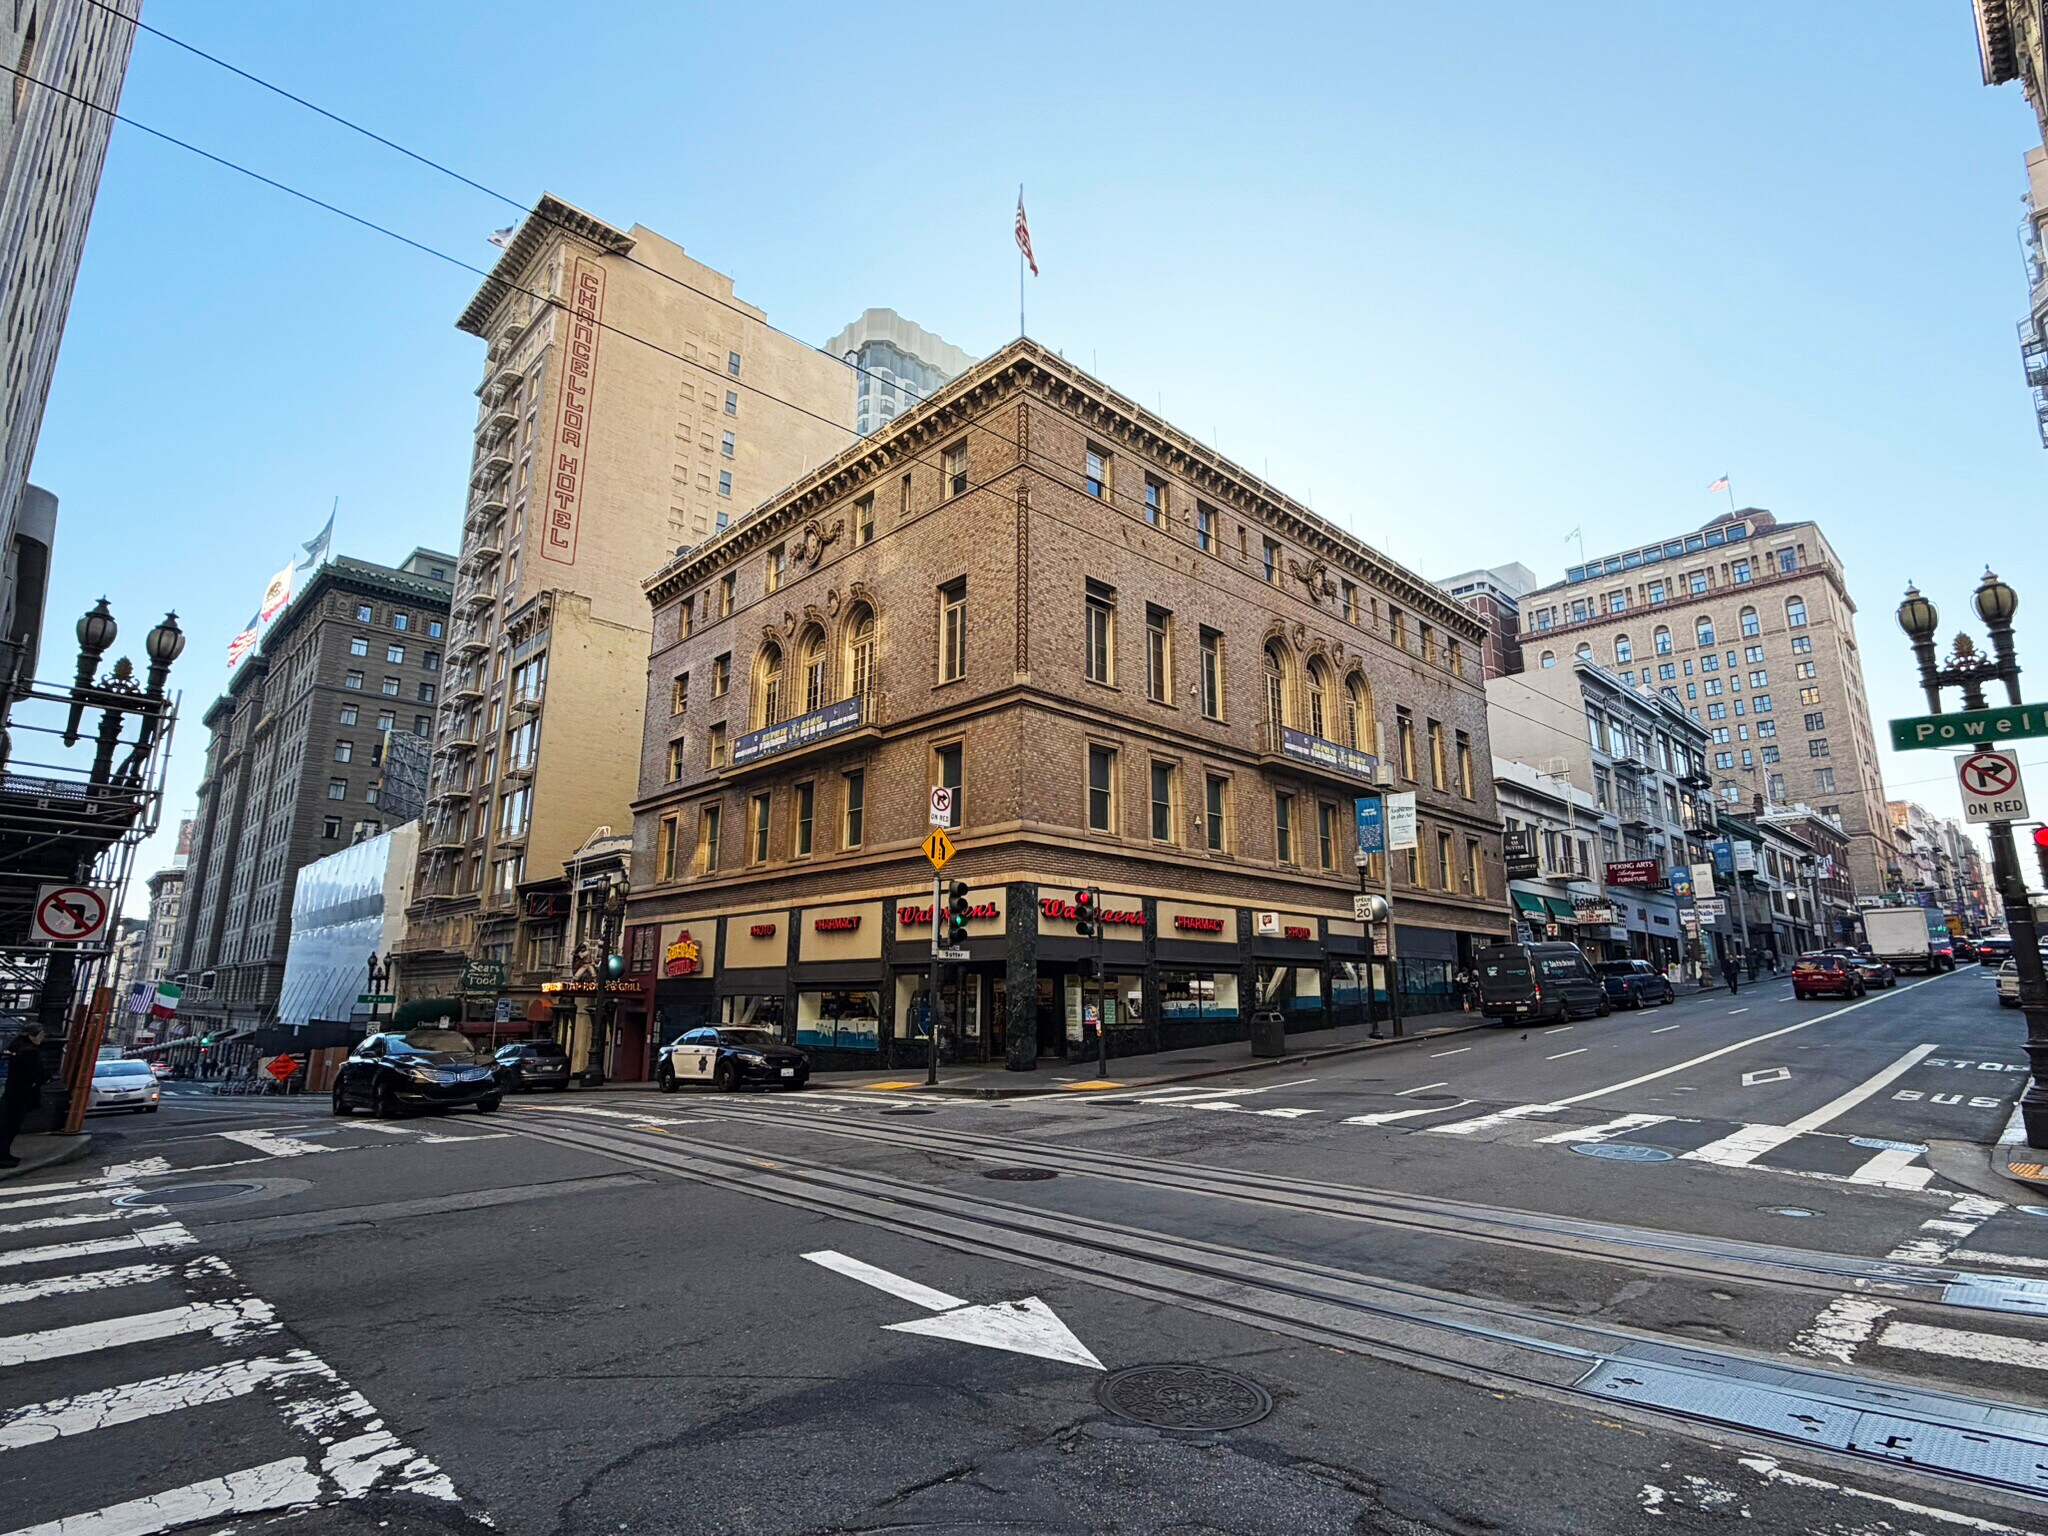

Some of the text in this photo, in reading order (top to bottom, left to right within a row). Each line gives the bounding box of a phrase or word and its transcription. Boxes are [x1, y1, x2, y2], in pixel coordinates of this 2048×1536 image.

[550, 271, 598, 549] CHANCELLOR HOTEL
[1968, 800, 2023, 815] ON RED
[939, 814, 949, 823] RED
[1610, 860, 1654, 871] PEKING ARTS
[1357, 908, 1371, 918] 20
[815, 917, 860, 930] PHARMACY
[1177, 915, 1226, 933] PHARMACY
[751, 925, 775, 936] PHOTO
[1288, 927, 1311, 939] PHOTO
[470, 961, 500, 973] Sears
[467, 972, 497, 986] Food
[618, 982, 642, 991] GRILL
[1923, 1058, 2032, 1072] STOP
[1891, 1089, 2002, 1108] BUS
